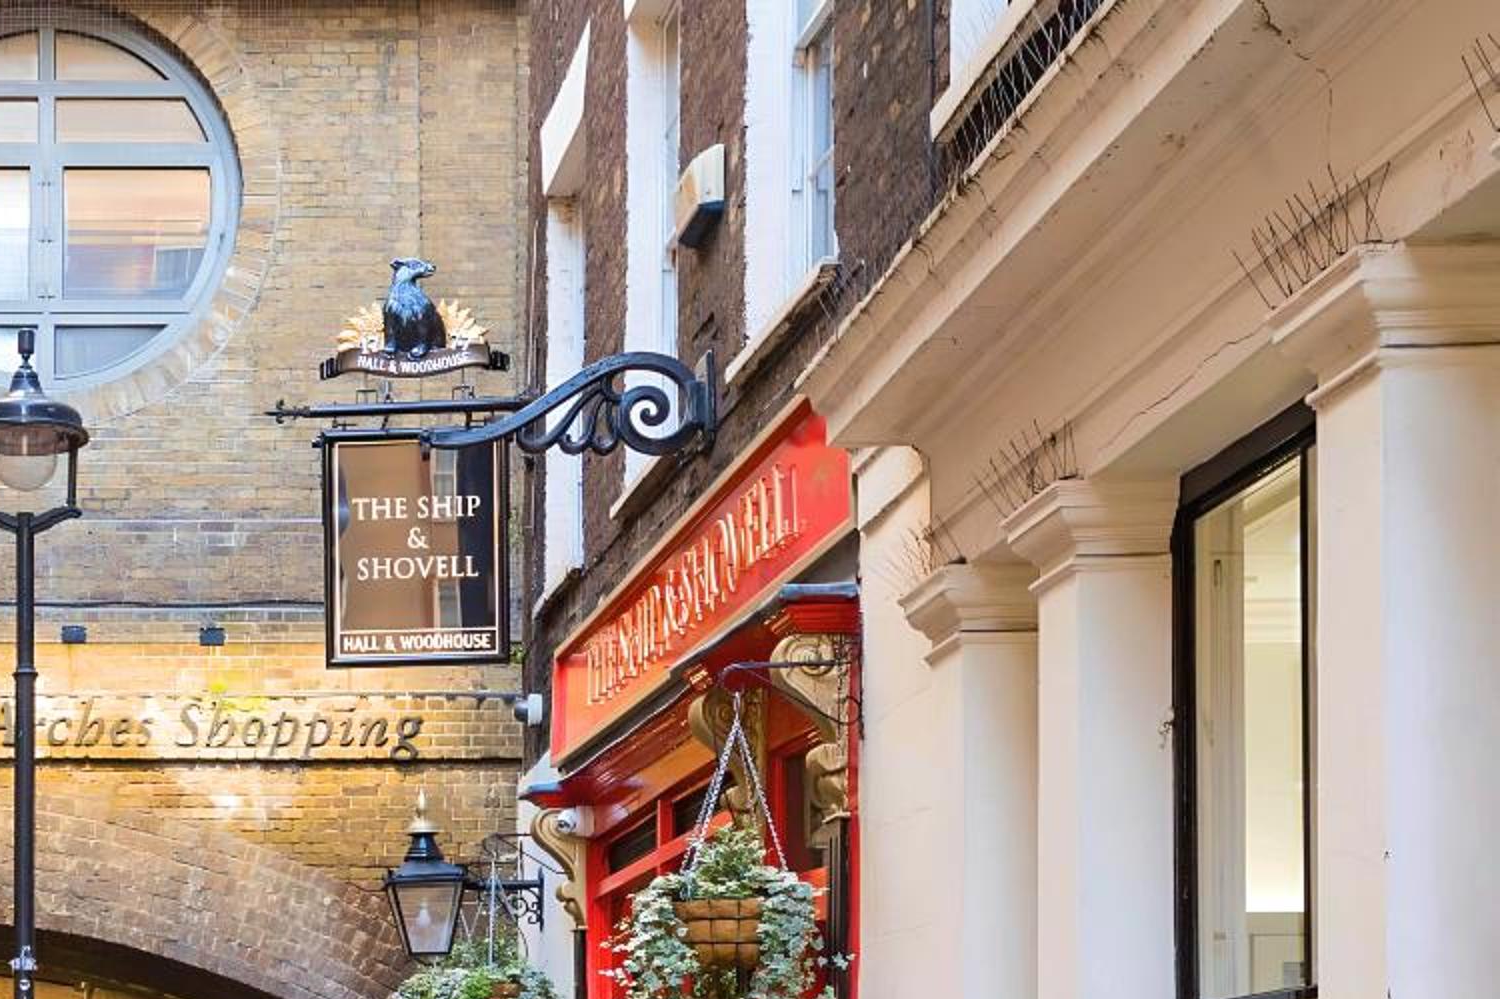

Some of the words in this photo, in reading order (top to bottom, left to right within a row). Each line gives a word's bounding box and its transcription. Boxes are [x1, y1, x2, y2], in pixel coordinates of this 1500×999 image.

[356, 354, 386, 371] HALL
[387, 359, 399, 375] &
[400, 352, 471, 374] WOODHOUSE
[351, 496, 408, 521] THE
[417, 494, 482, 519] SHIP
[406, 526, 430, 550] &
[356, 555, 479, 581] SHOVELL
[343, 635, 380, 653] HALL
[384, 634, 397, 653] &
[399, 632, 492, 651] WOODHOUSE
[174, 701, 426, 762] Shopping
